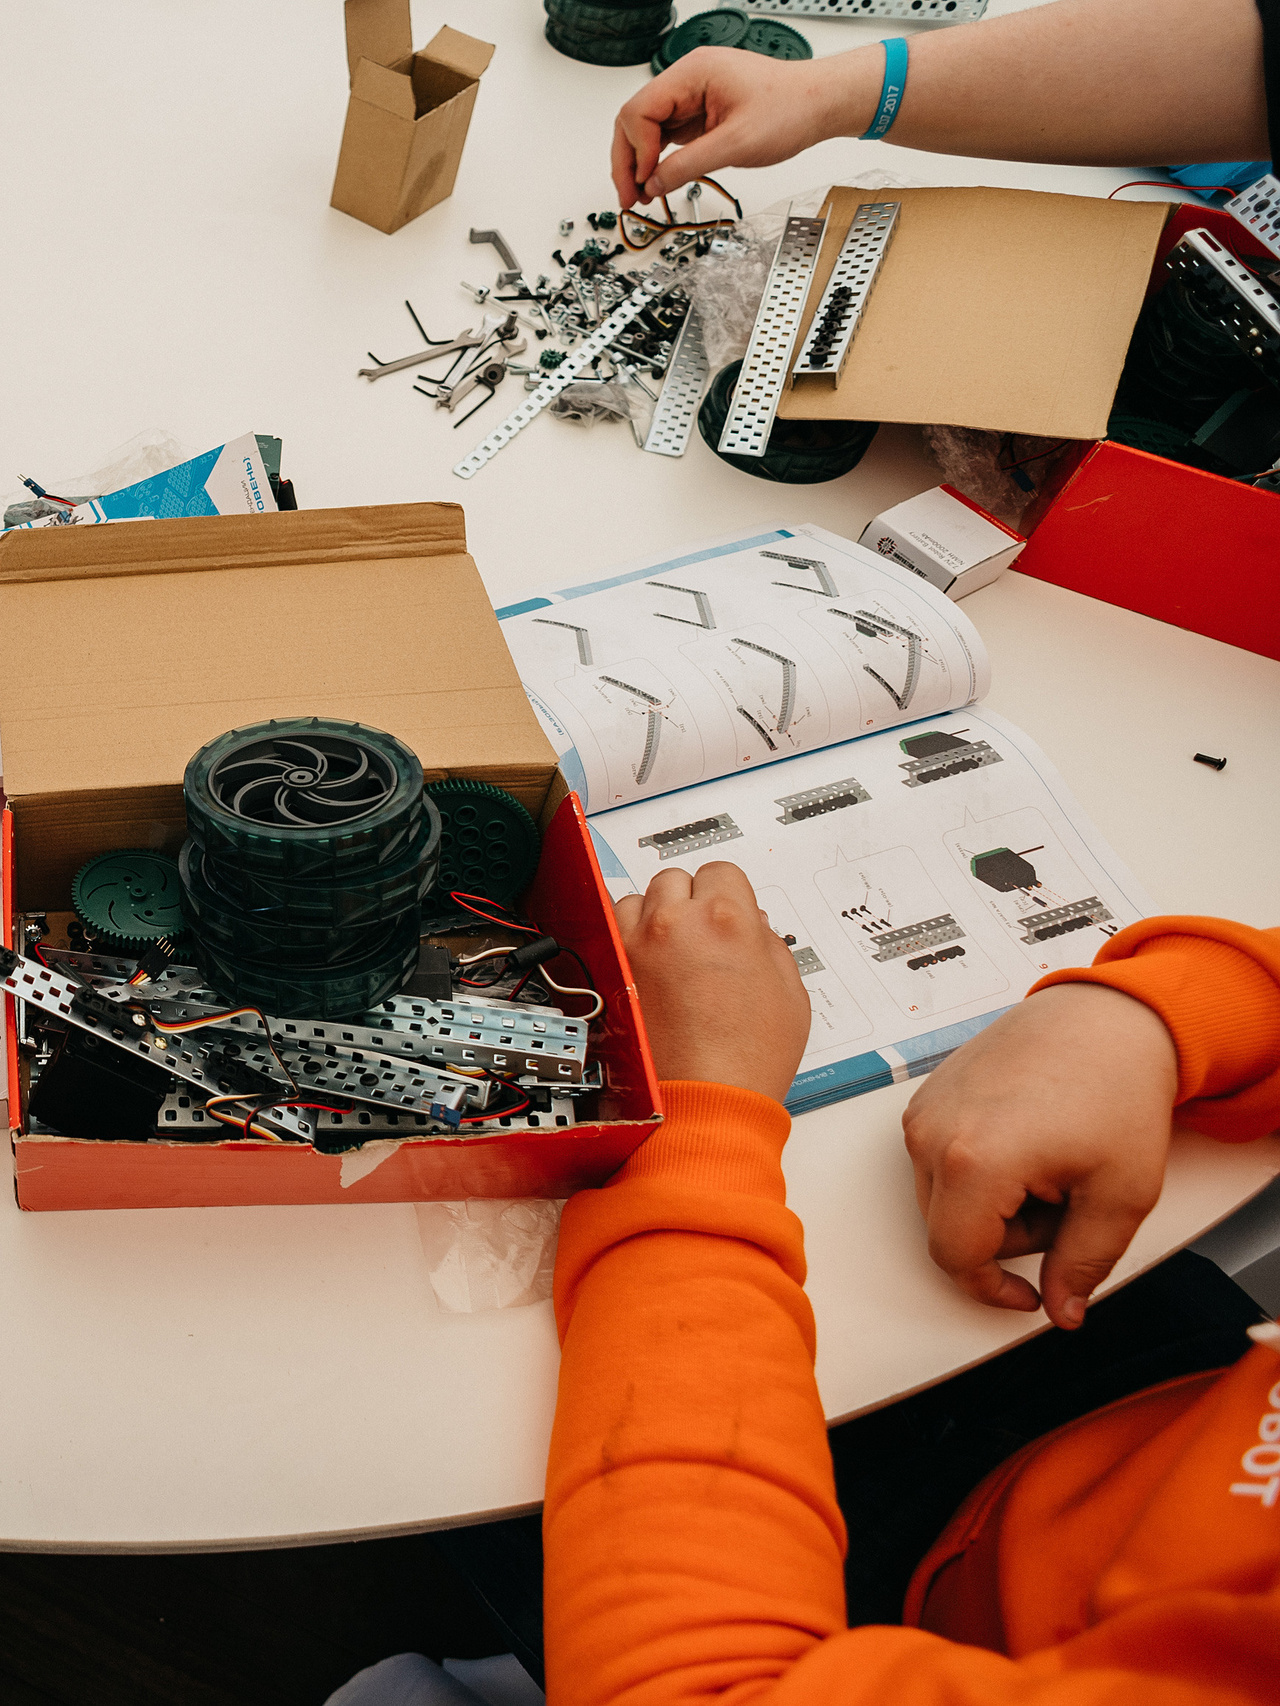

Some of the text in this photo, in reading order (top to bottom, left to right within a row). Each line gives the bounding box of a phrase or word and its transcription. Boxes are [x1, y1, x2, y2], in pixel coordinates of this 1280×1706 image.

[243, 457, 264, 512] ОВЕНЬ)
[241, 479, 254, 513] ЕНДАЦИИ
[908, 1004, 918, 1012] 5
[826, 1067, 834, 1075] 3
